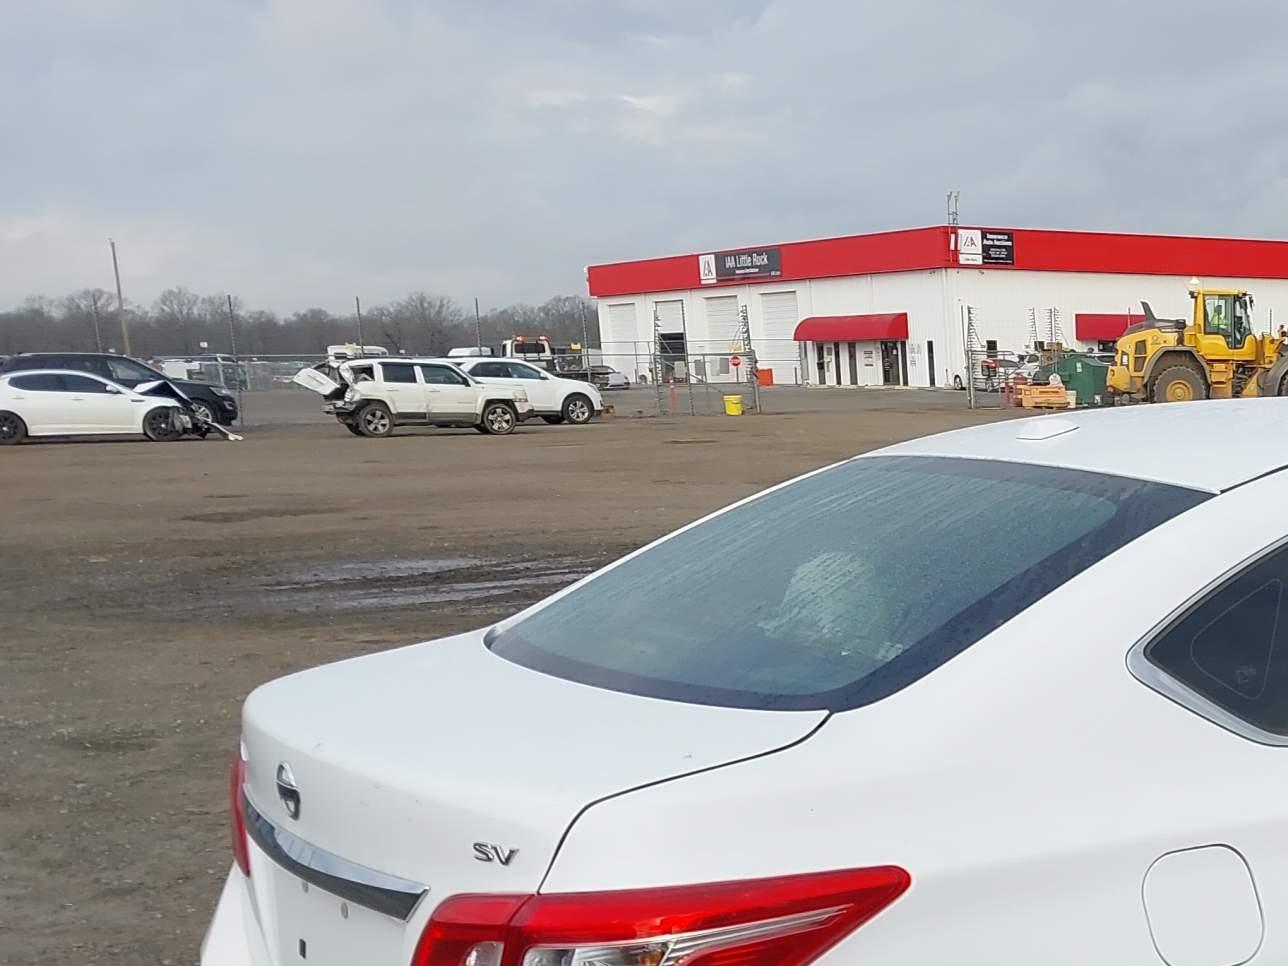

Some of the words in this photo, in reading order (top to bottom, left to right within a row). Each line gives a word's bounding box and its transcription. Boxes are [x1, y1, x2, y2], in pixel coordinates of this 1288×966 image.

[736, 254, 752, 268] Little
[752, 252, 769, 266] Rock
[473, 842, 520, 866] SV
